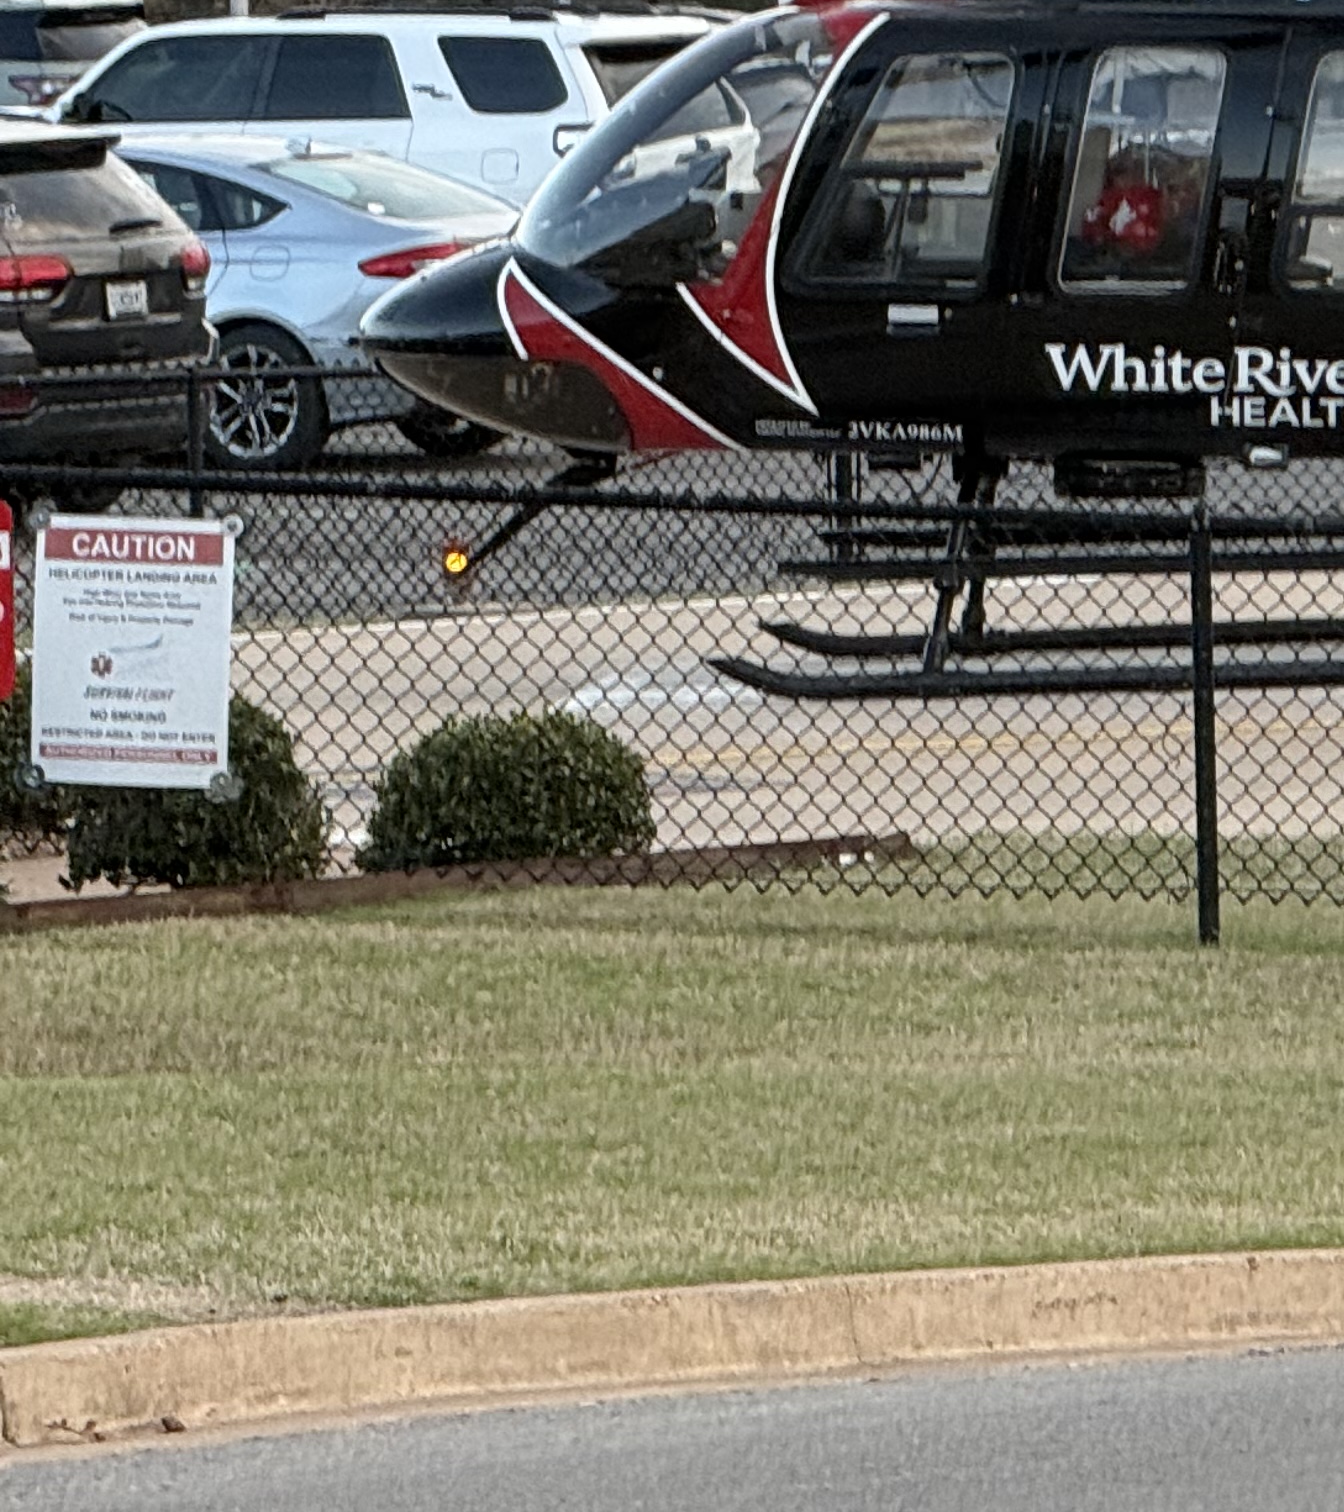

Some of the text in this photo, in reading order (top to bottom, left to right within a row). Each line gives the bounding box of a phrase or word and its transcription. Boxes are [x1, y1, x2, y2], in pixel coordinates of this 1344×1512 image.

[1044, 342, 1225, 392] White
[72, 532, 195, 561] CAUTION
[183, 572, 218, 584] AREA
[90, 708, 108, 721] NO
